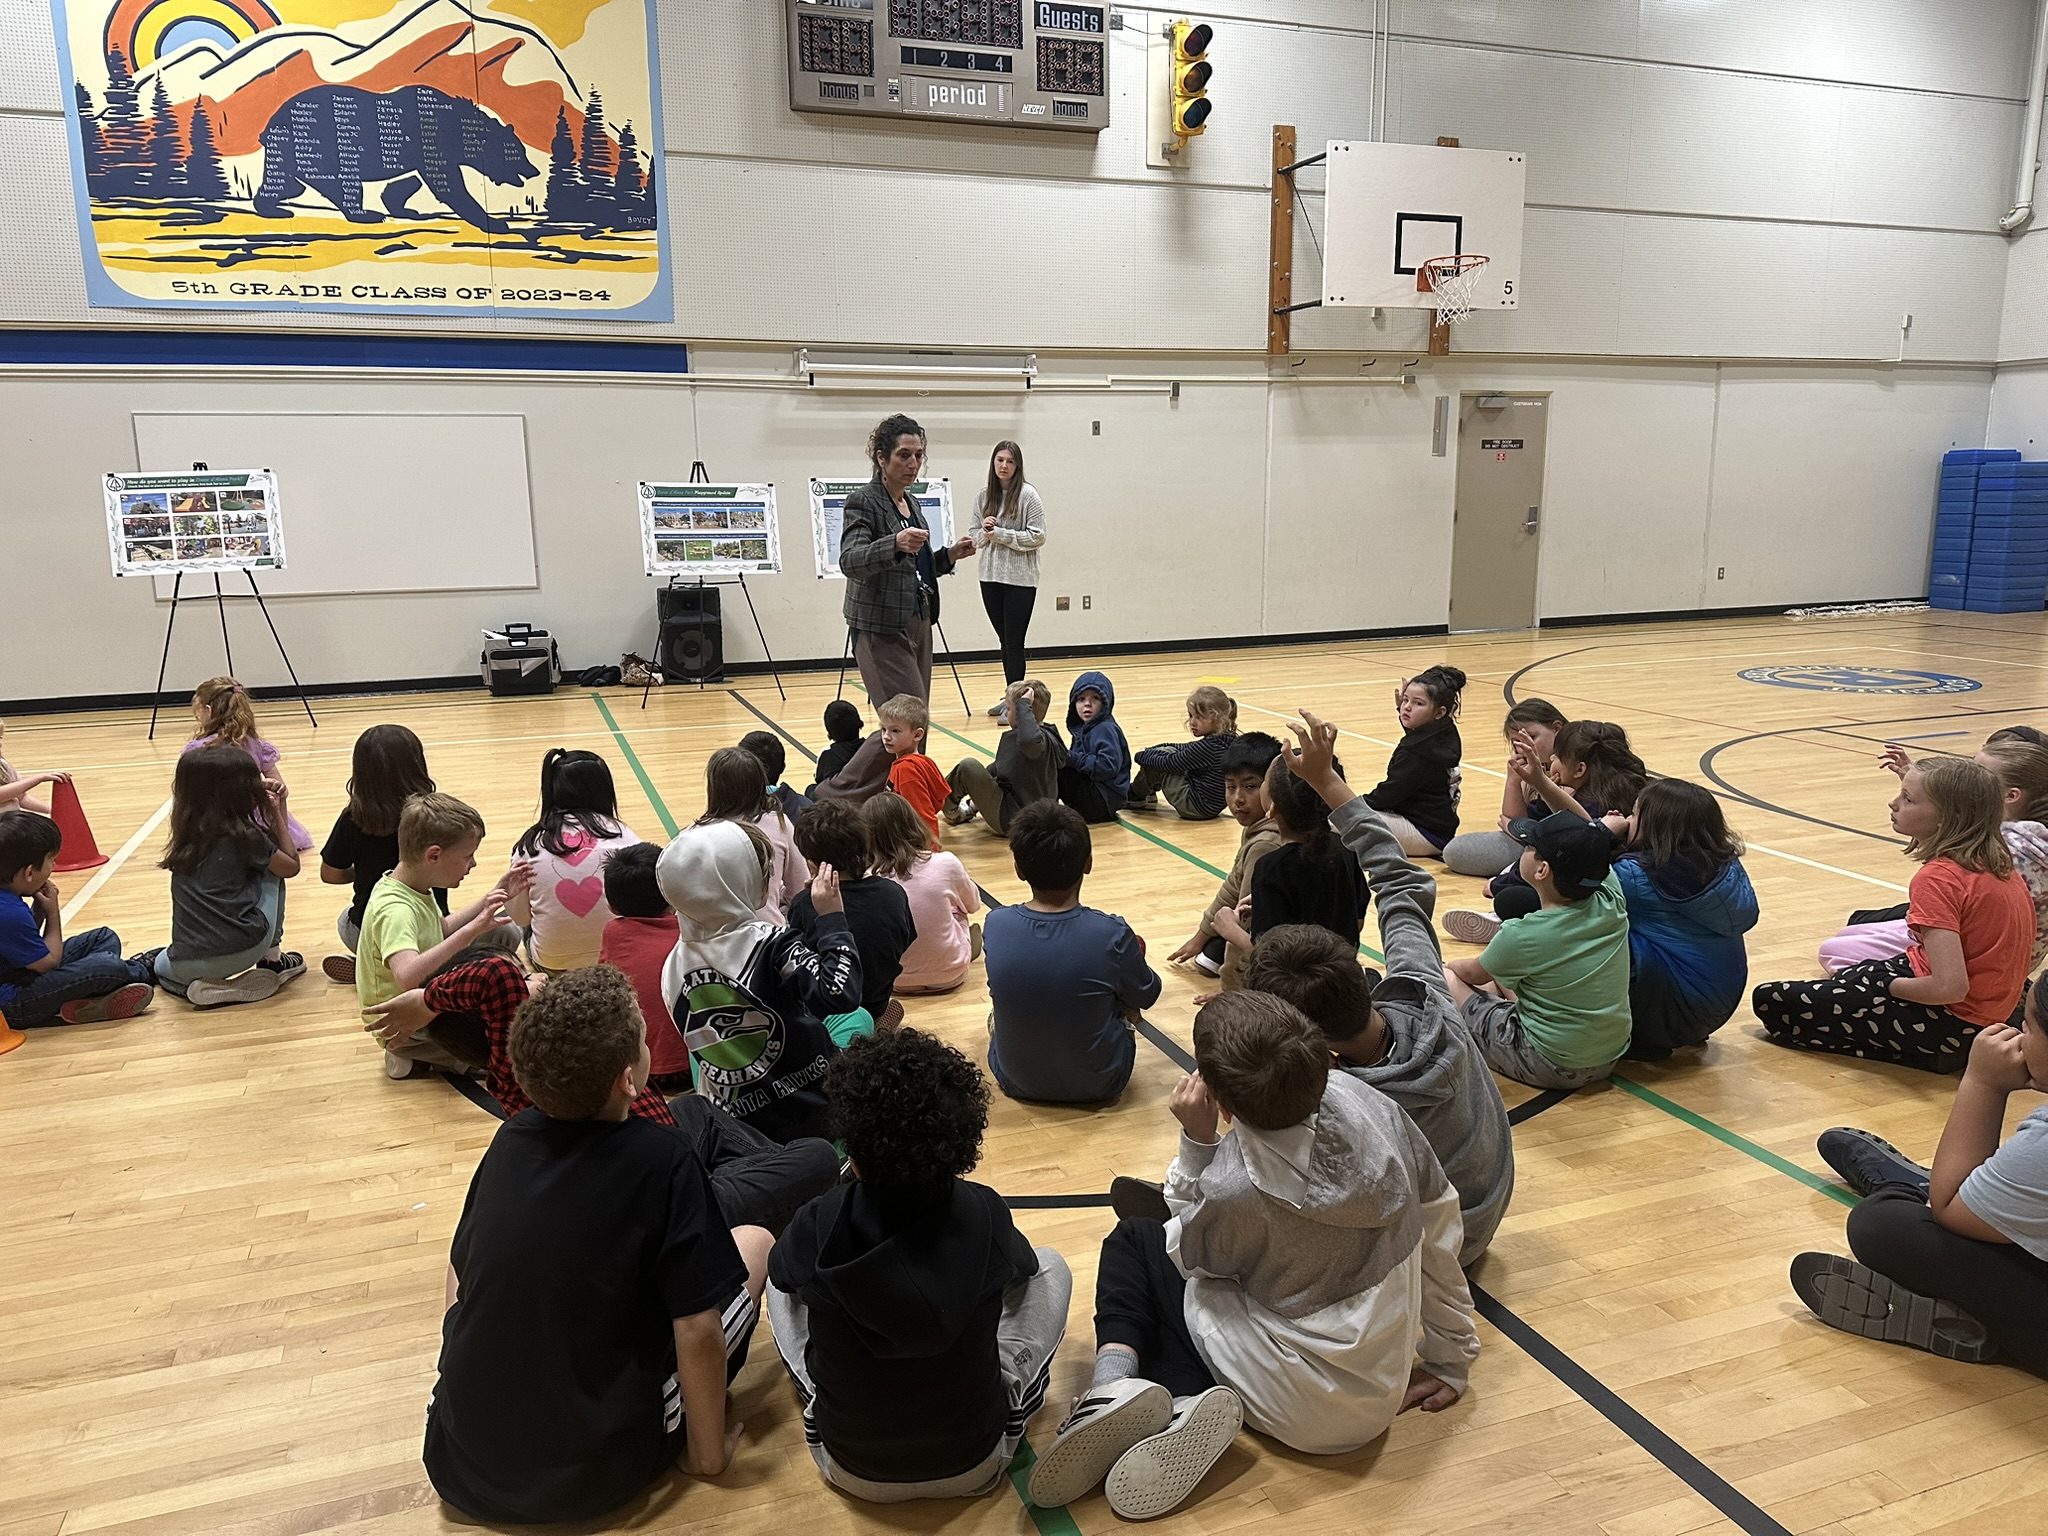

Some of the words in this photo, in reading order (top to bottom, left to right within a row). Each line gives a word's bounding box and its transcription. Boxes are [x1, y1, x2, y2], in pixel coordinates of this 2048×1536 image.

[1039, 4, 1100, 32] Guests
[940, 51, 948, 67] 2
[967, 54, 975, 70] 3
[995, 56, 1004, 71] 4
[821, 82, 858, 99] bonus
[928, 84, 986, 107] period
[1054, 102, 1087, 117] bonus
[172, 281, 216, 296] 5th
[230, 282, 342, 298] GRADE
[351, 284, 448, 300] CLASS
[456, 286, 492, 300] OF
[500, 288, 612, 302] 2023-24
[1504, 280, 1513, 295] 5
[700, 1040, 780, 1084] SEAHAWKS
[772, 1054, 830, 1098] HAWKS
